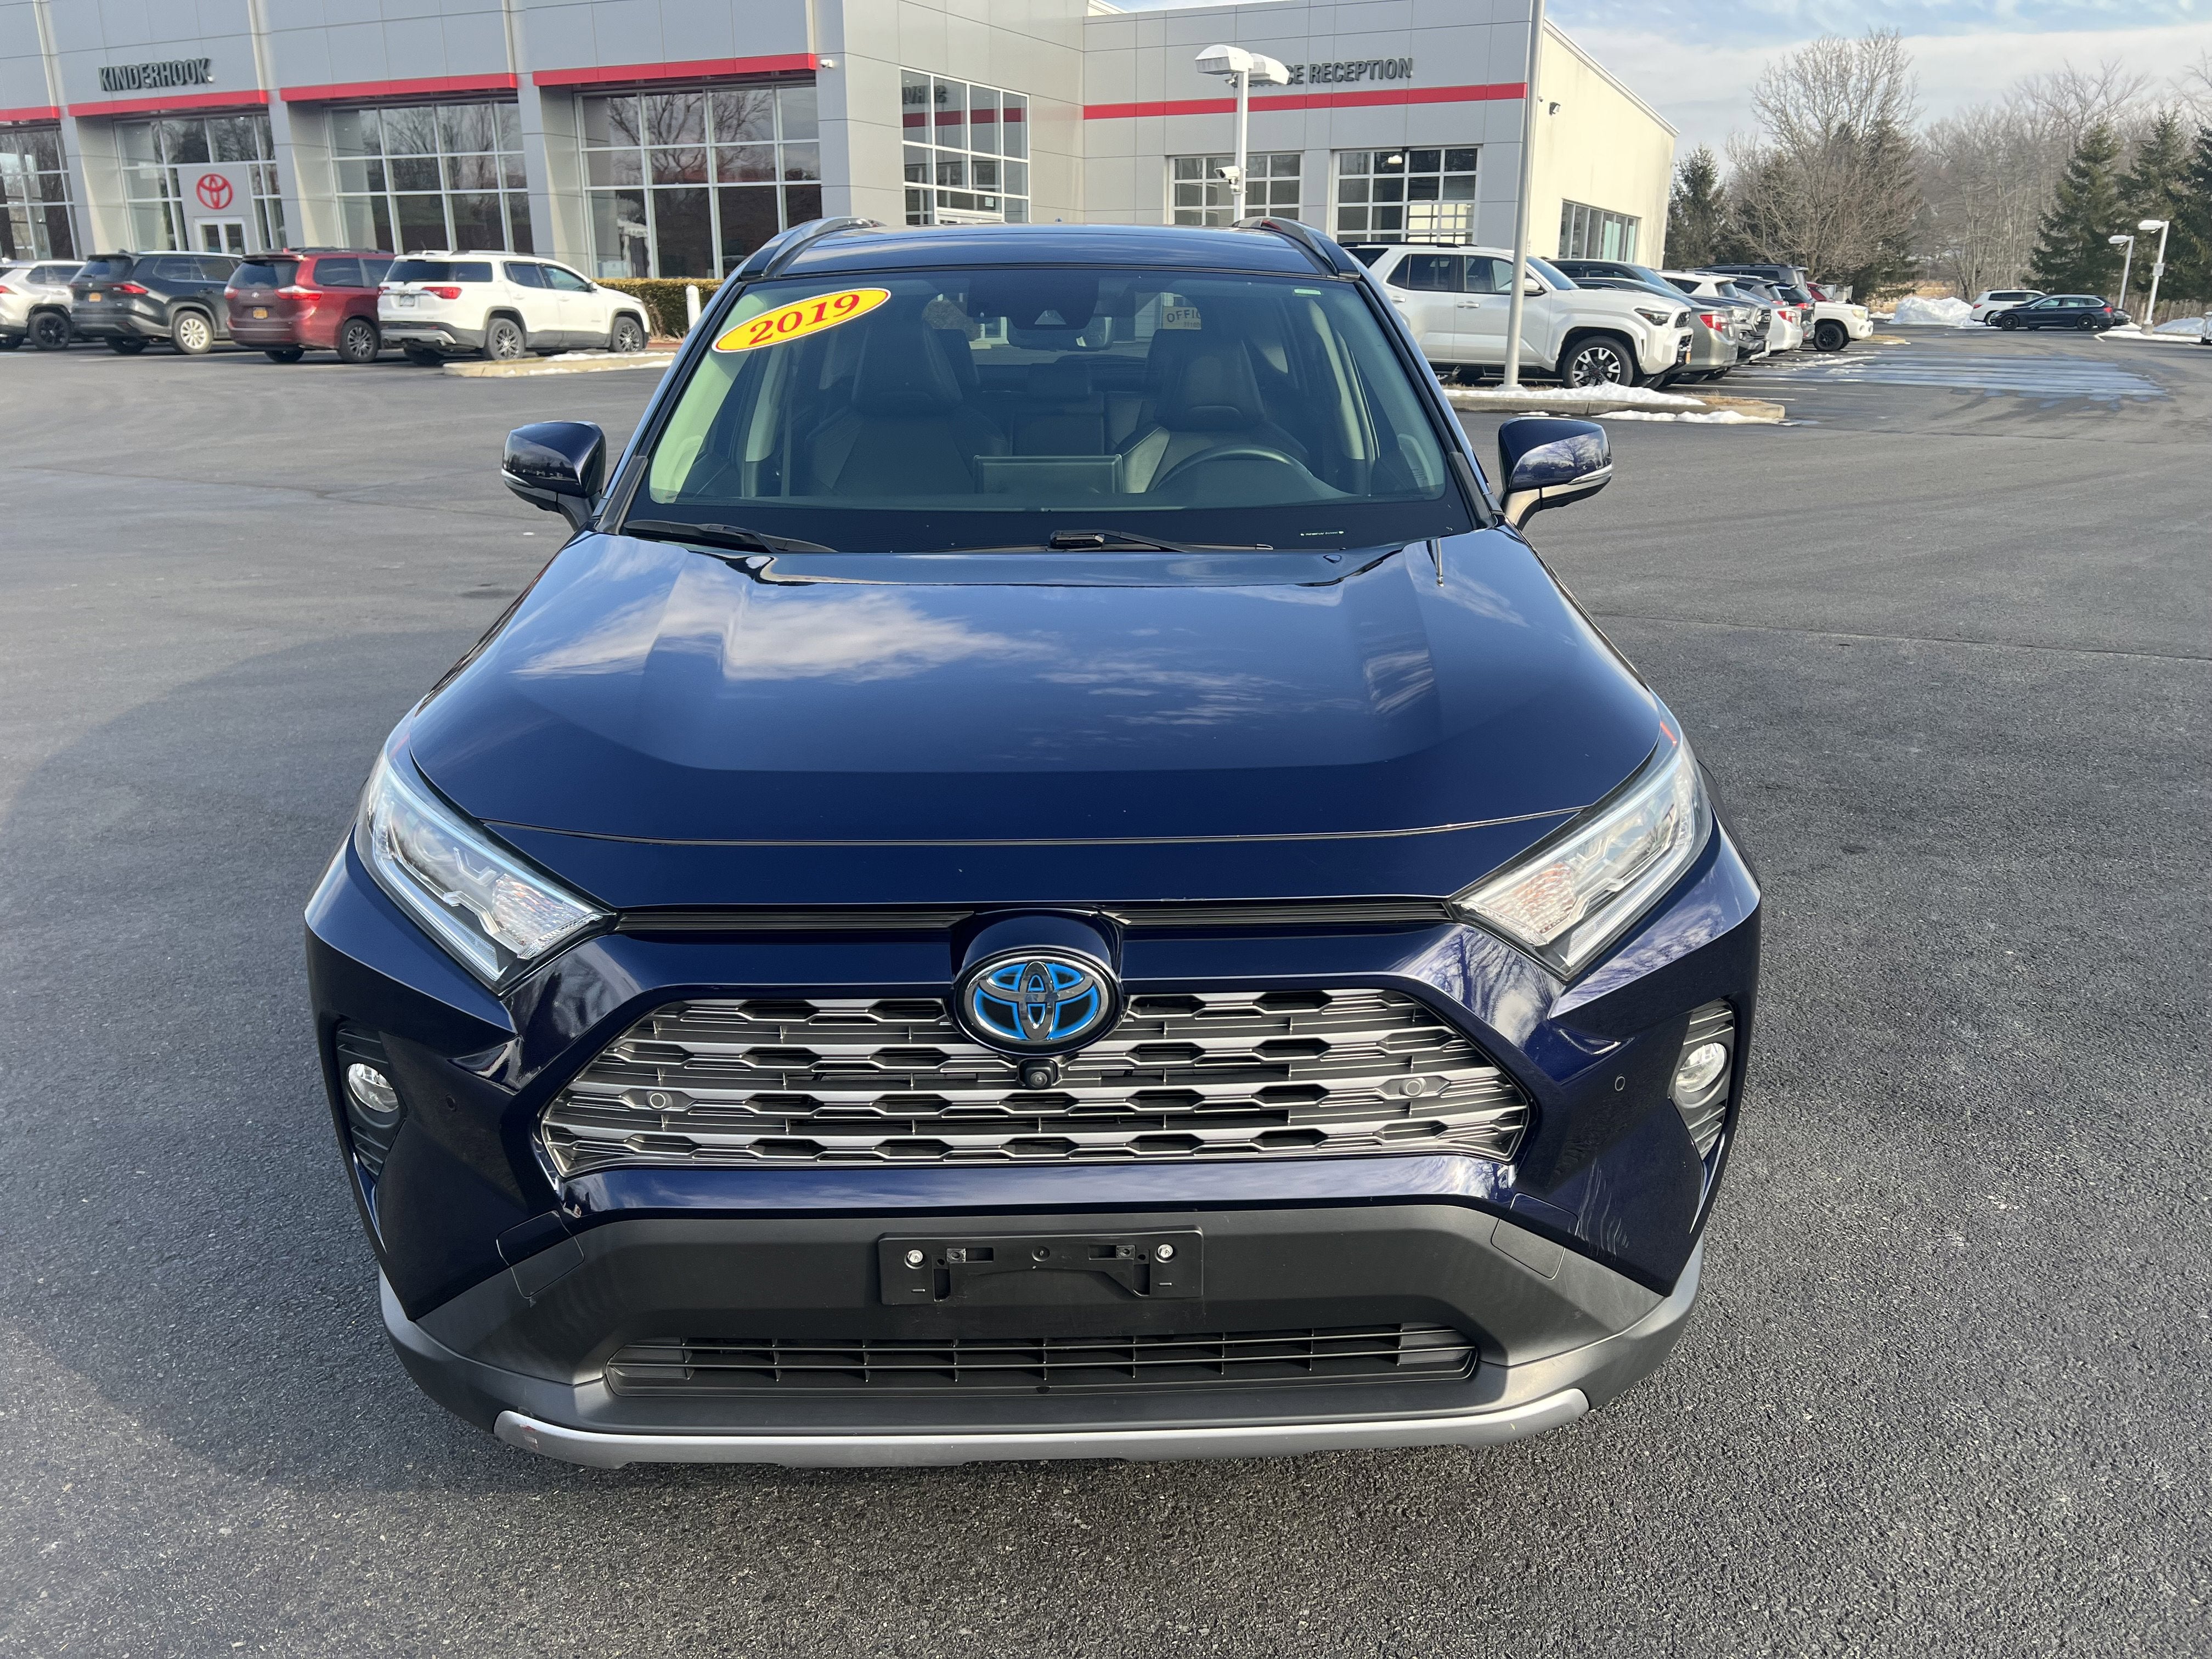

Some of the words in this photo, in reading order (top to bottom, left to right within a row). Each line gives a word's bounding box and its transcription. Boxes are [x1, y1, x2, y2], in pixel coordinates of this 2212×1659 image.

[98, 58, 211, 91] KINDERHOOK
[1309, 58, 1413, 83] RECEPTION
[749, 294, 859, 345] 2019
